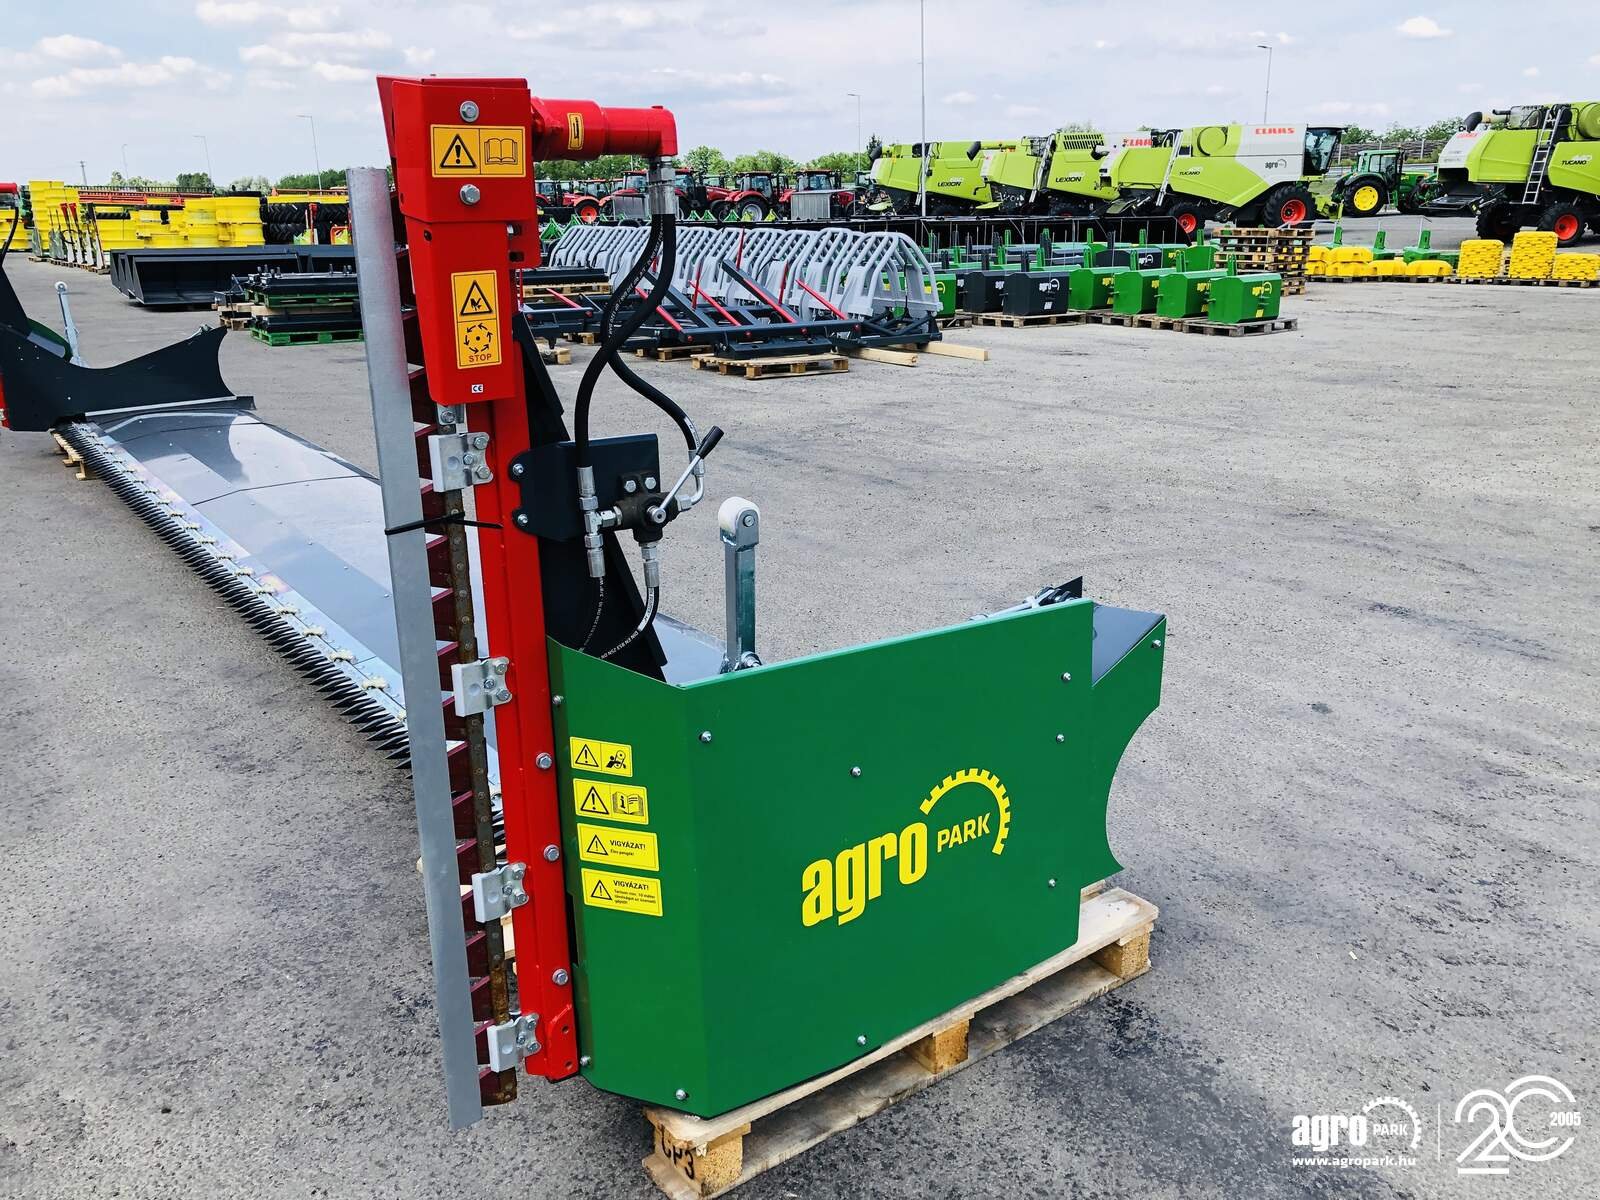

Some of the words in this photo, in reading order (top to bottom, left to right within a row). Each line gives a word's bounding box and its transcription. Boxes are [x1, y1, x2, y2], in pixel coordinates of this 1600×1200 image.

[468, 353, 492, 362] STOP
[610, 839, 646, 850] VIGYÁZAT!
[802, 822, 928, 927] agro
[936, 812, 992, 853] PARK
[613, 880, 648, 890] VIGYÁZAT!
